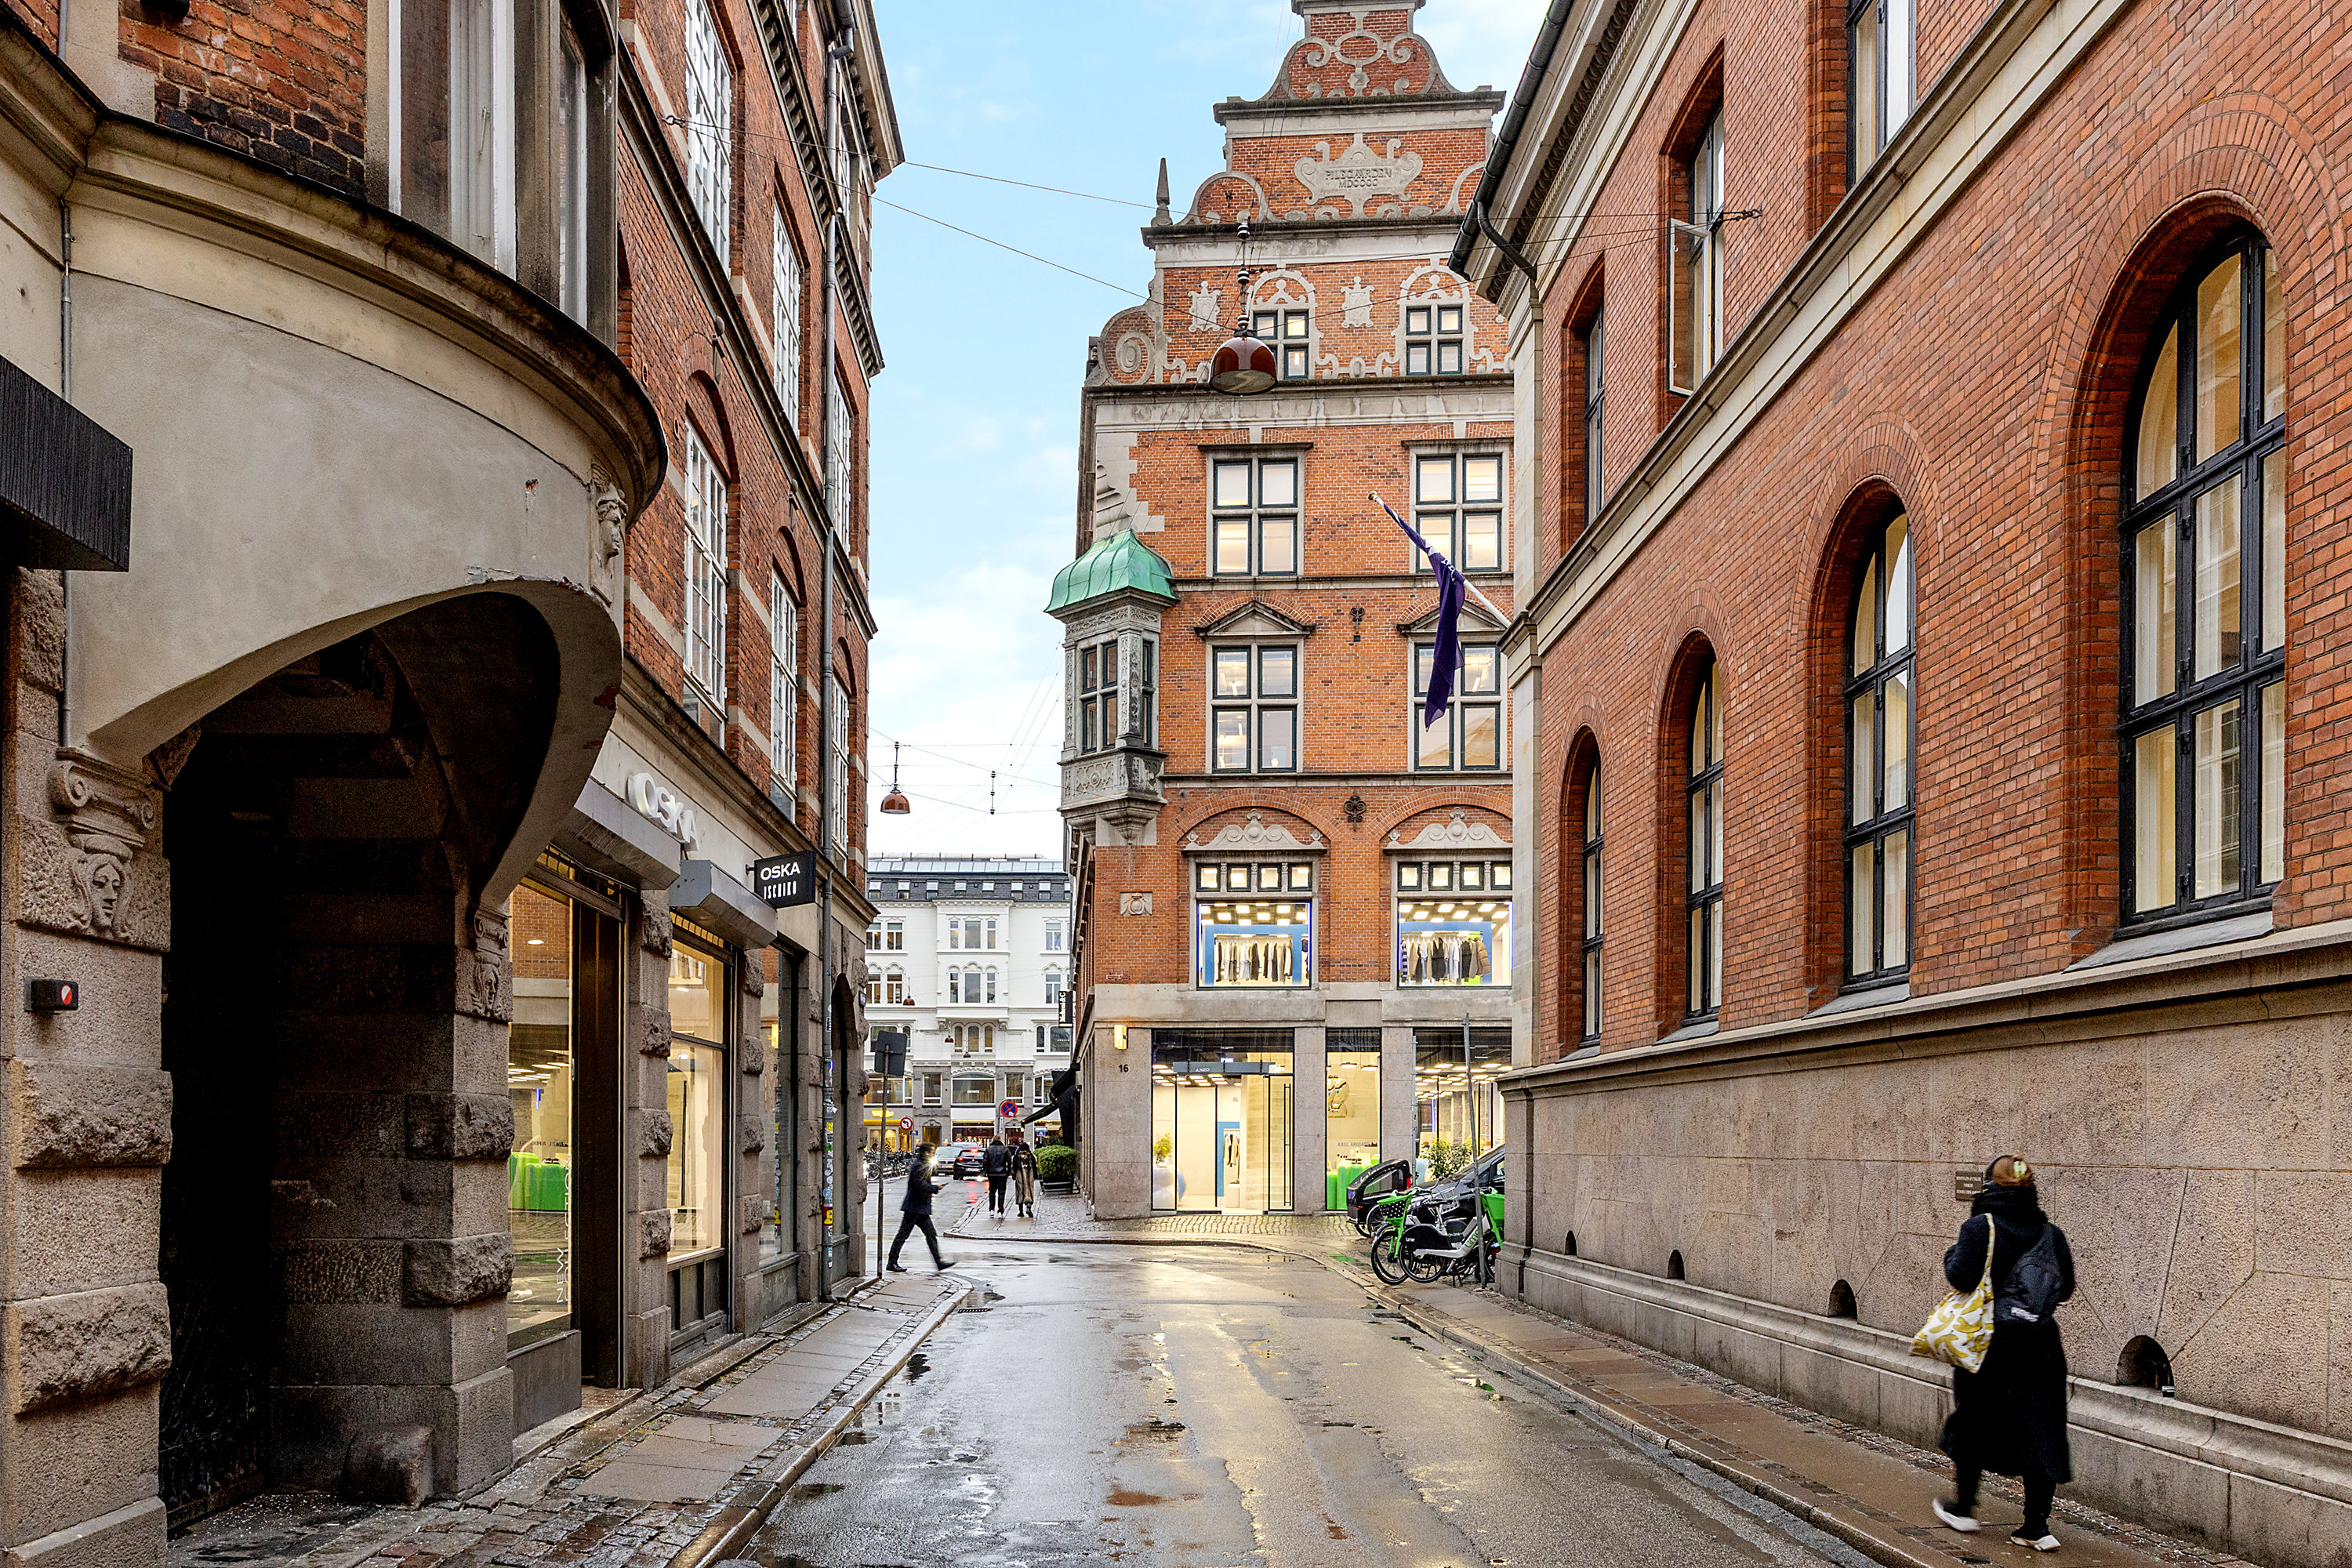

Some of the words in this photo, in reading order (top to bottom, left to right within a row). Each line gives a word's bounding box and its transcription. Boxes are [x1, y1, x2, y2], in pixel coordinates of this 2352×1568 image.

[628, 772, 700, 851] OSKA
[760, 862, 800, 881] OSKA
[764, 880, 797, 900] ISCHIKO
[1118, 1064, 1129, 1073] 16
